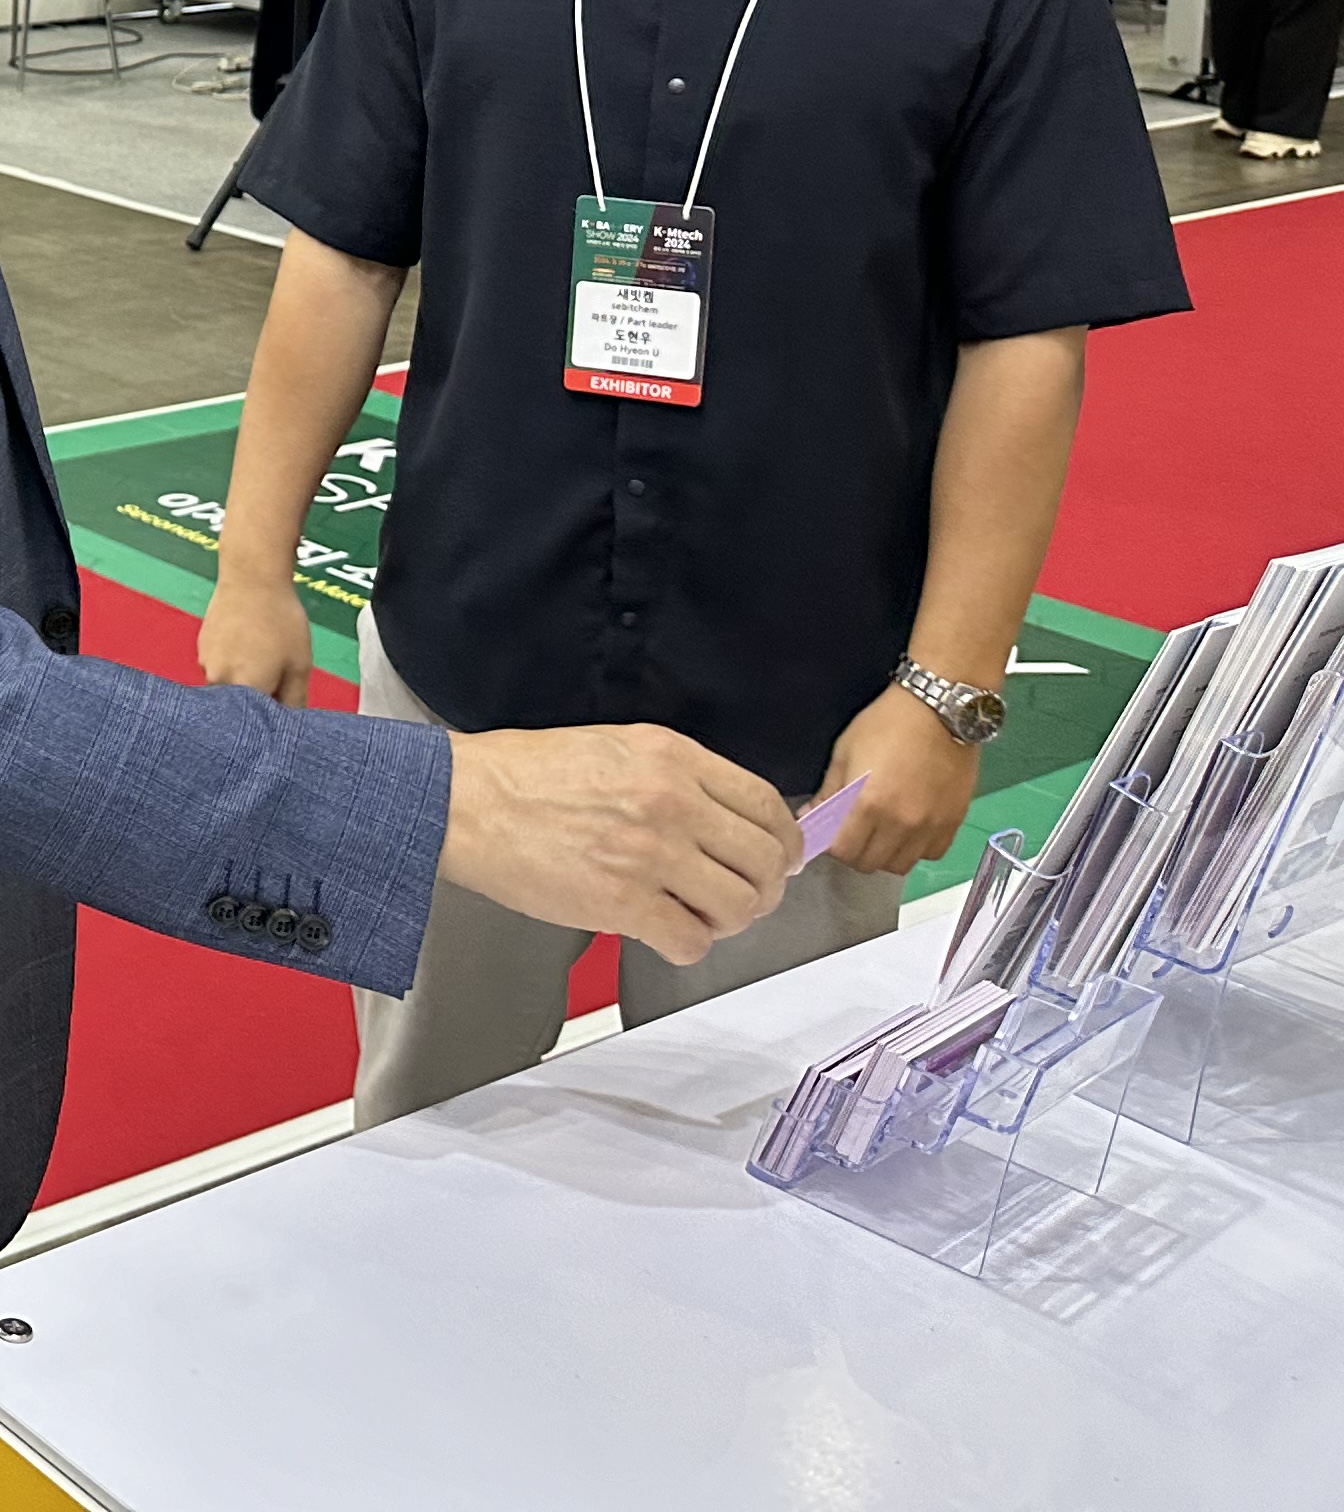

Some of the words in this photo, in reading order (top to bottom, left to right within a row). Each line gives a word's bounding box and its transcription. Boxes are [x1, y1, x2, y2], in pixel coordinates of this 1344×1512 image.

[664, 238, 691, 249] 2024
[627, 316, 646, 327] Part
[648, 319, 678, 331] leader
[604, 342, 617, 352] Do
[590, 376, 672, 399] EXHIBITOR
